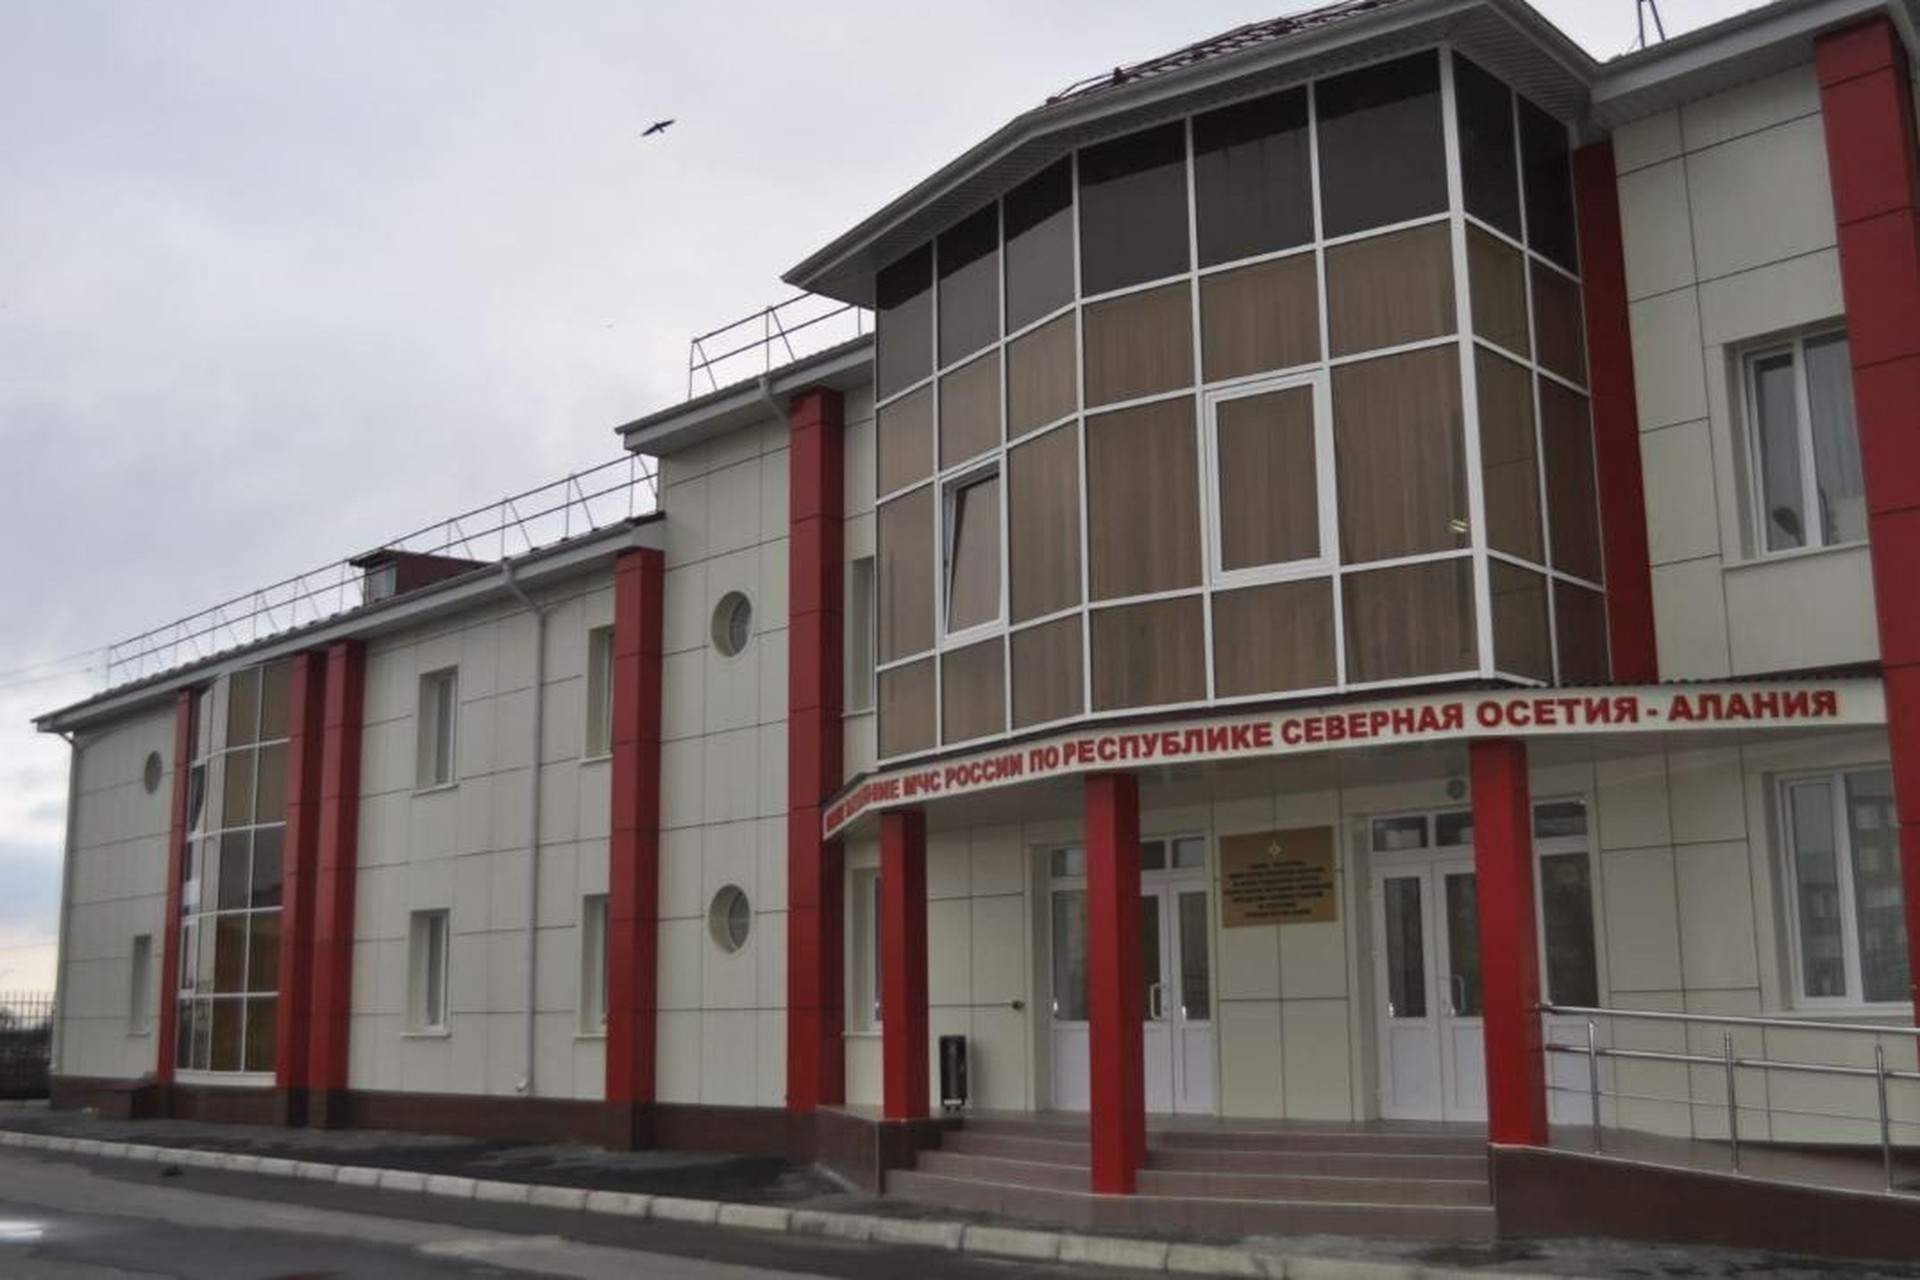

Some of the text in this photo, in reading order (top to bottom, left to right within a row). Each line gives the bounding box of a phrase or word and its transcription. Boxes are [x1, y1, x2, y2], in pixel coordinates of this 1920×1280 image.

[945, 753, 1023, 789] РОССИИ
[1029, 744, 1059, 772] ПО
[1063, 722, 1273, 766] РЕСПУБЛИКЕ
[1281, 703, 1464, 745] СЕВЕРНАЯ
[1476, 697, 1639, 728] ОСЕТИЯ
[1668, 690, 1838, 722] АЛАНИЯ
